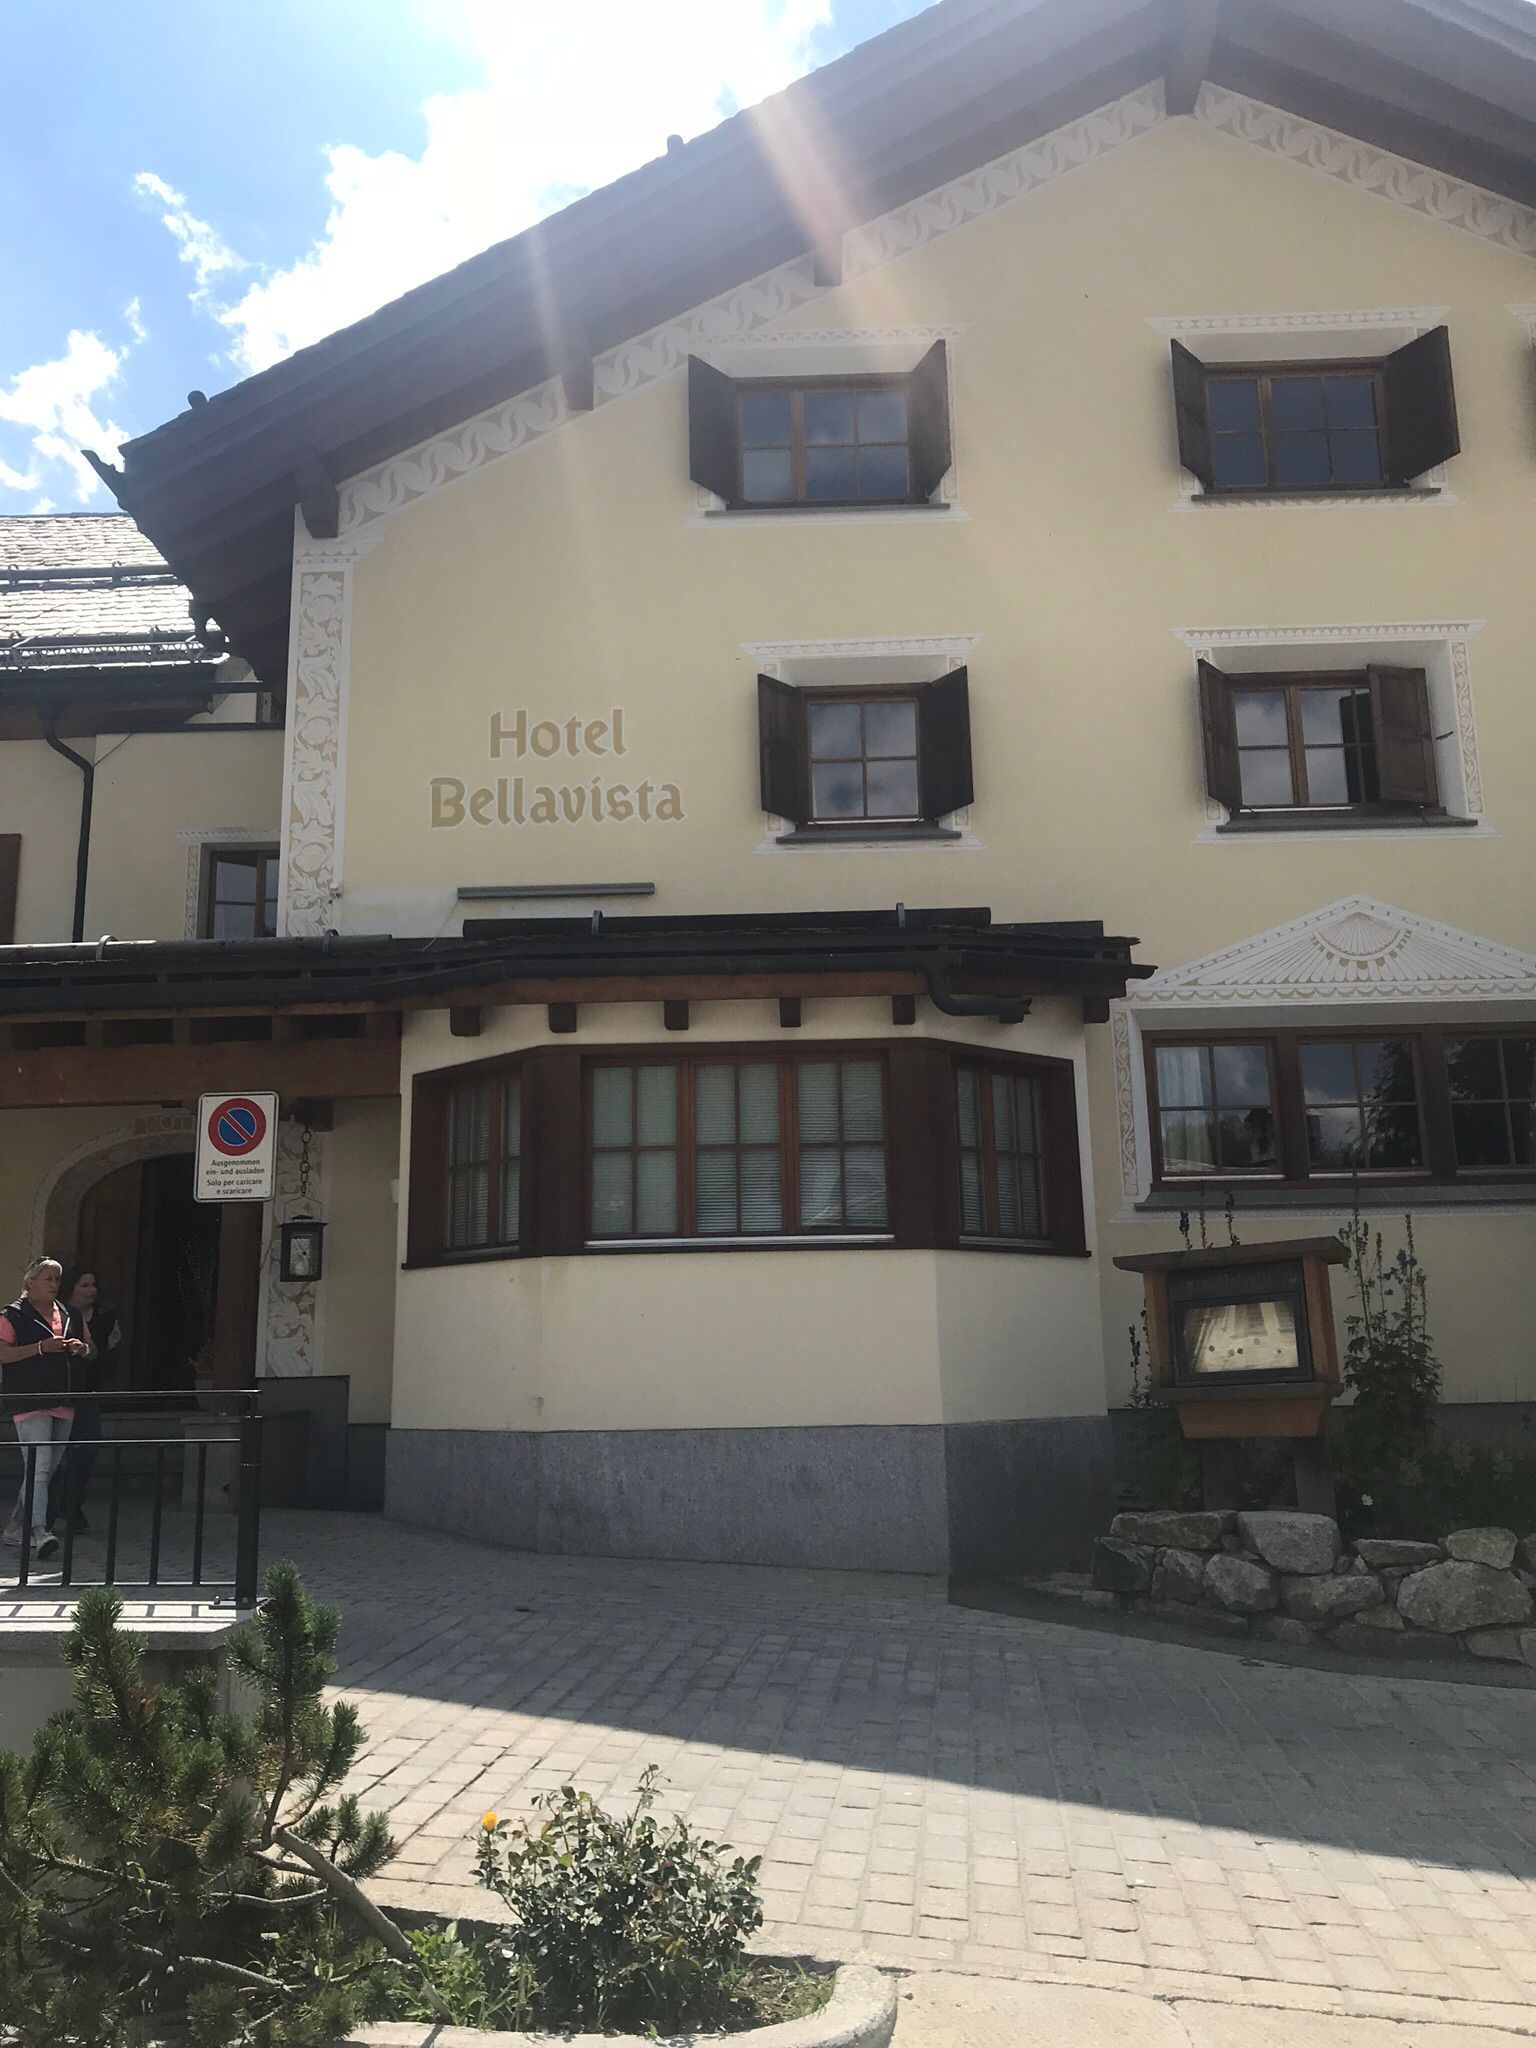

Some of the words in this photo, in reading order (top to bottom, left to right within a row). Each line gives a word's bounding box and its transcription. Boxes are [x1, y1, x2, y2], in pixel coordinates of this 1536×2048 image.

[489, 707, 627, 759] Hotel
[428, 775, 686, 828] Bellavista
[211, 1159, 261, 1168] Ausgenommen
[223, 1180, 235, 1188] per
